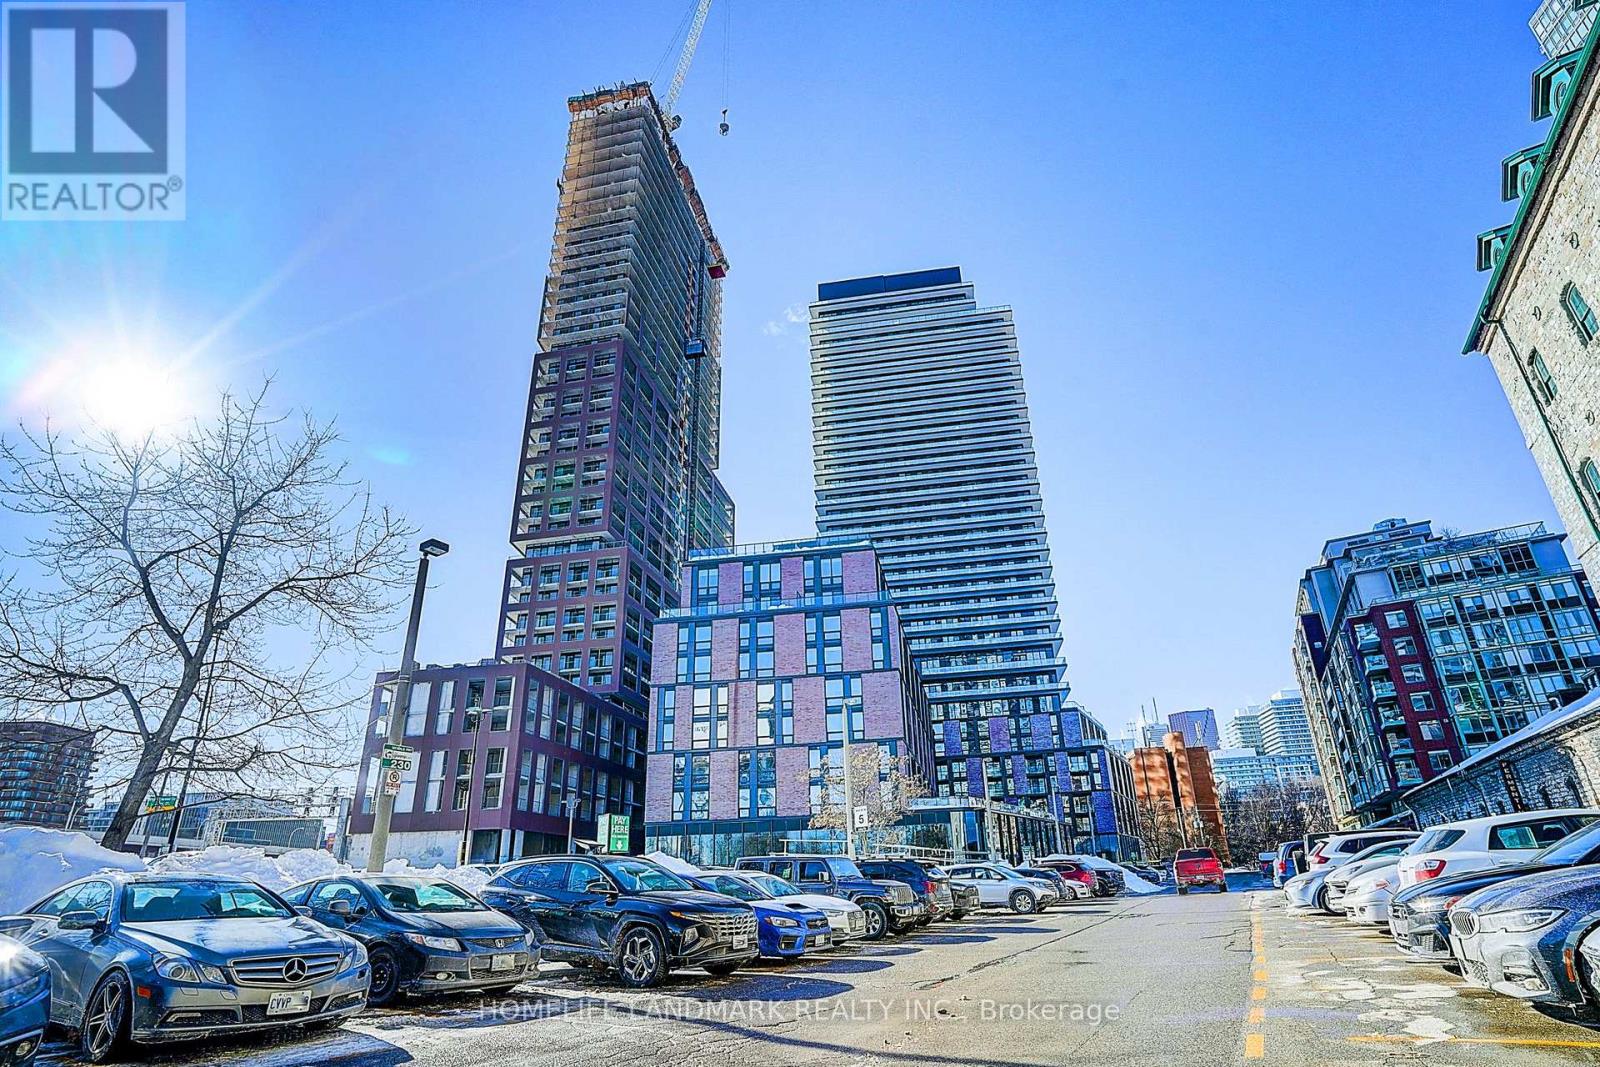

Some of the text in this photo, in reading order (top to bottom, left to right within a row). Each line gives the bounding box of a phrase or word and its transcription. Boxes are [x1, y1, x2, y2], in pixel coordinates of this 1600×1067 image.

[391, 759, 411, 770] 230
[614, 815, 627, 824] PAY
[858, 814, 865, 824] 5
[611, 825, 628, 833] HERE
